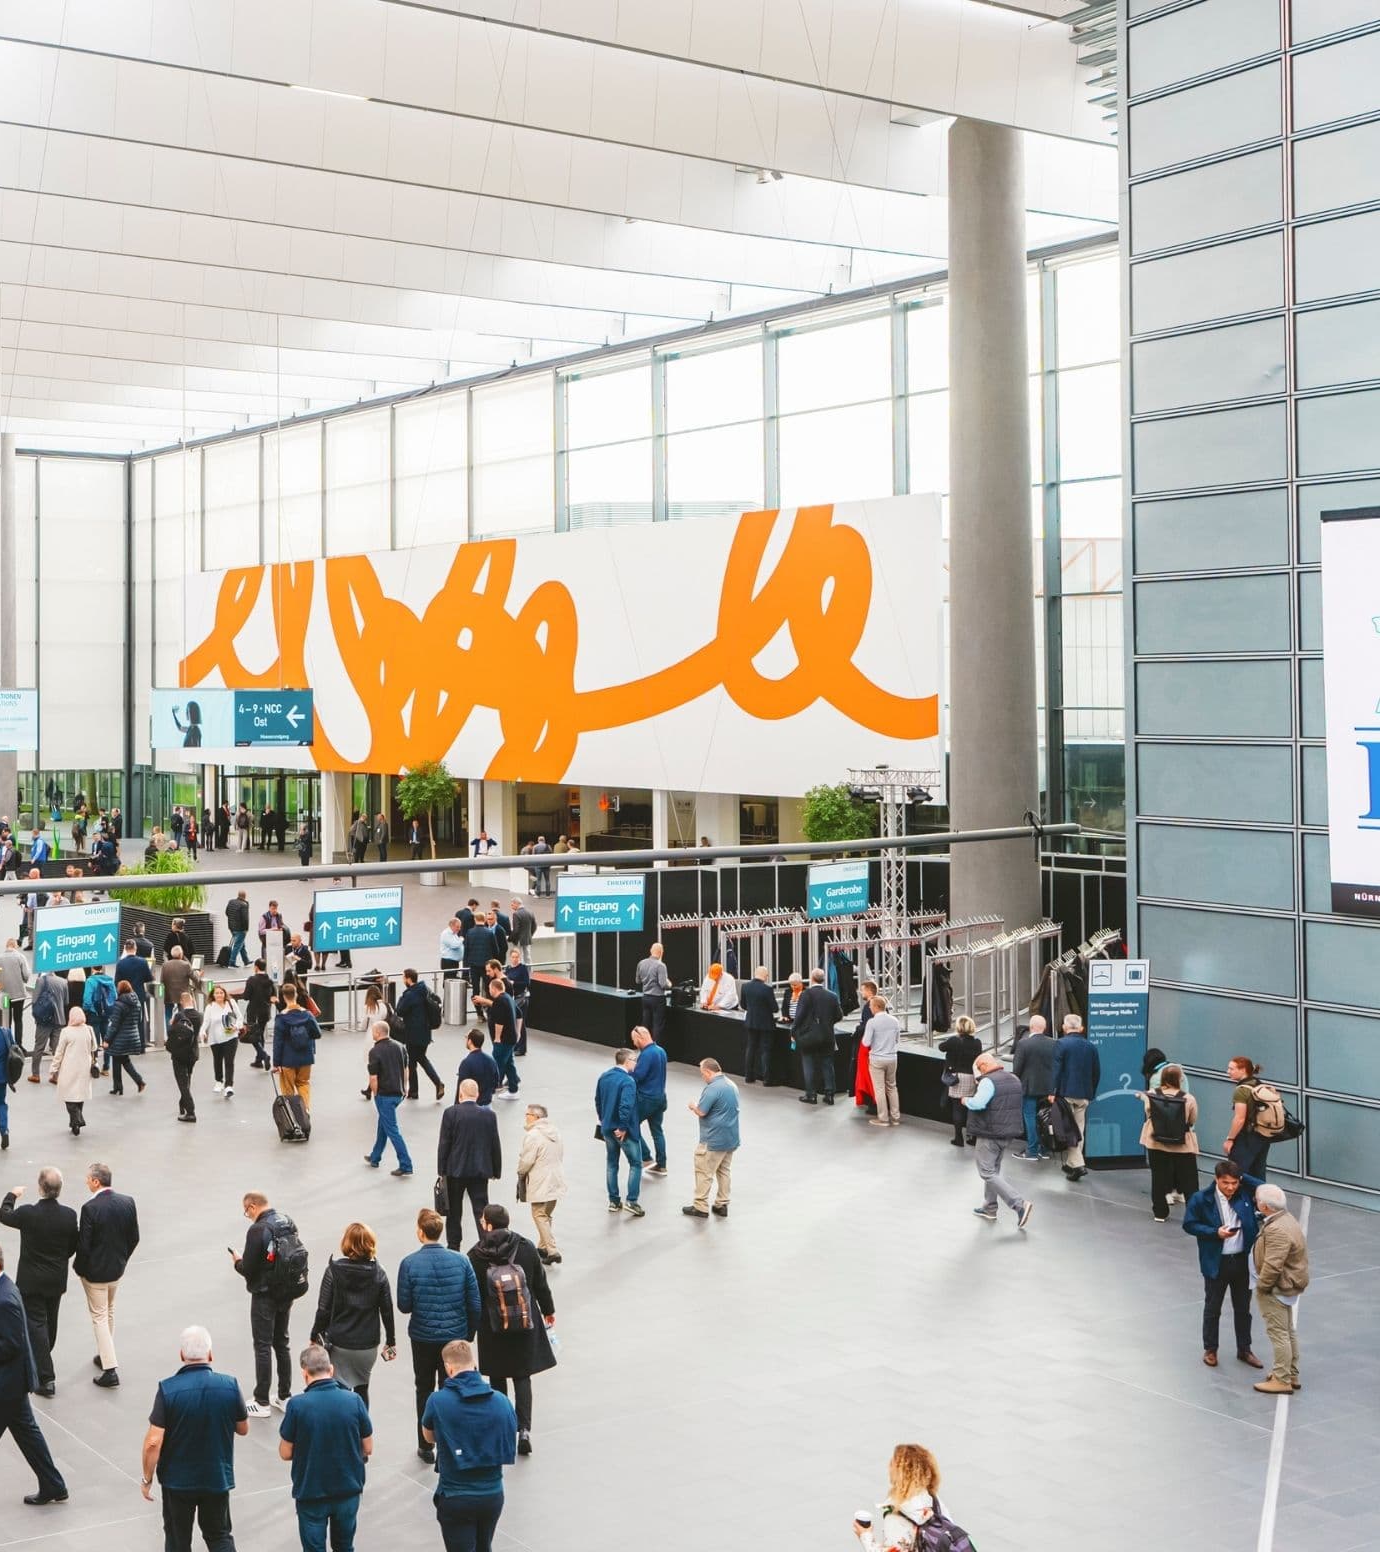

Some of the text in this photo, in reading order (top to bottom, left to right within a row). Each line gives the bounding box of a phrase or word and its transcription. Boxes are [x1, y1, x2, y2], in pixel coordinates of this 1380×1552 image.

[238, 704, 245, 714] 4
[252, 704, 258, 714] 9
[264, 704, 282, 714] NCC
[253, 717, 268, 727] Ost
[825, 884, 862, 897] Garderobe
[578, 901, 619, 913] Eingang
[825, 900, 865, 910] Cloak room
[336, 916, 377, 929] Eingang
[578, 916, 622, 926] Entrance
[56, 933, 96, 948] Eingang
[336, 932, 380, 943] Entrance
[56, 950, 98, 963] Entrance
